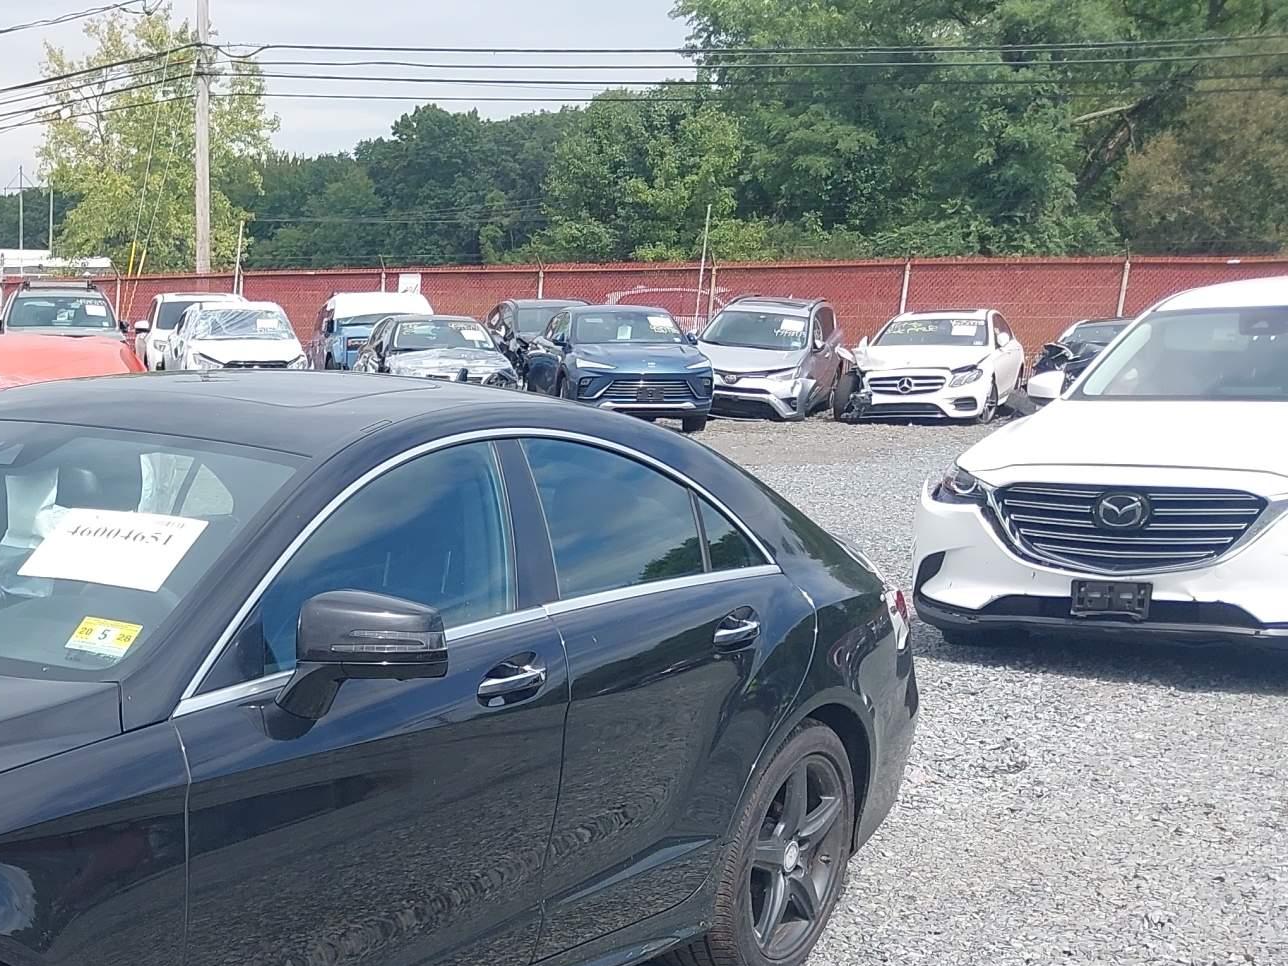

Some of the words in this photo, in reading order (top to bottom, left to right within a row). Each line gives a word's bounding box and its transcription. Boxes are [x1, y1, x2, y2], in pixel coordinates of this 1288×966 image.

[67, 524, 174, 545] 46004651
[78, 626, 94, 636] 20
[97, 628, 111, 641] 5
[116, 632, 132, 643] 28
